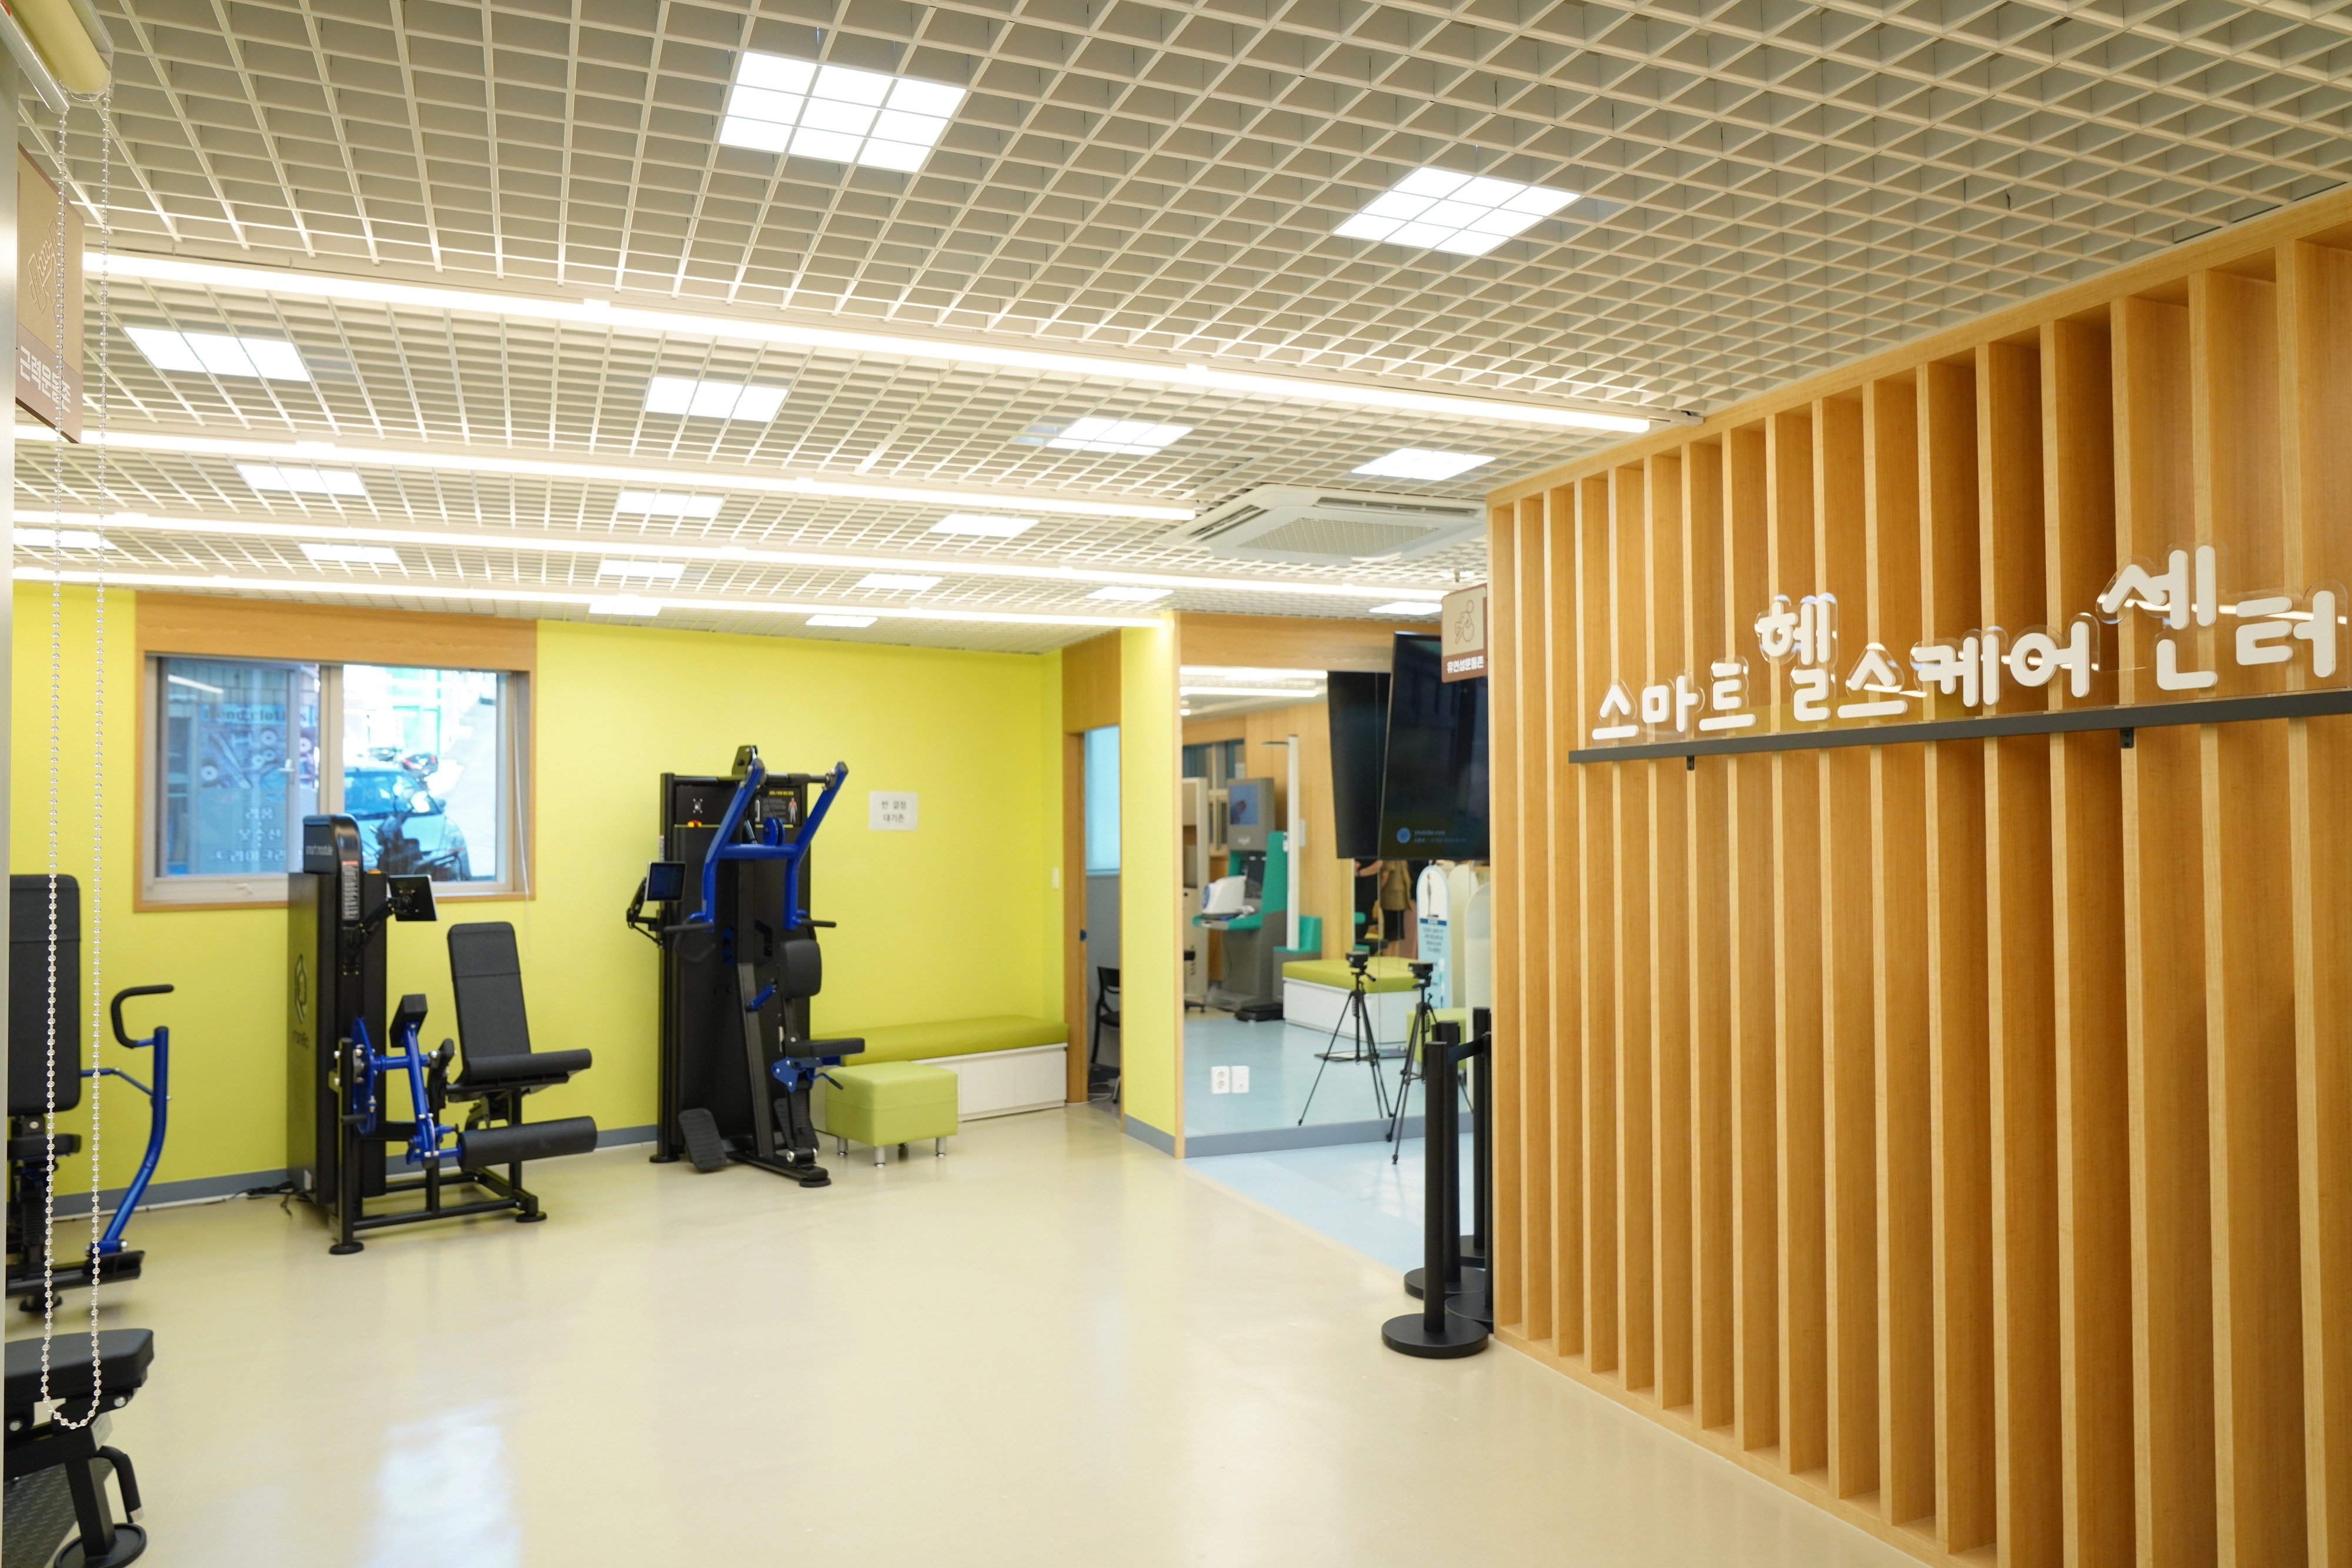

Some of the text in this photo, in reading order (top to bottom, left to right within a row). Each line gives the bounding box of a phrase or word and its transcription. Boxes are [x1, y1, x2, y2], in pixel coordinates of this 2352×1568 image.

[1446, 655, 1484, 674] 유연성운동존
[1592, 545, 2336, 741] 스마트 헬스케어 센터
